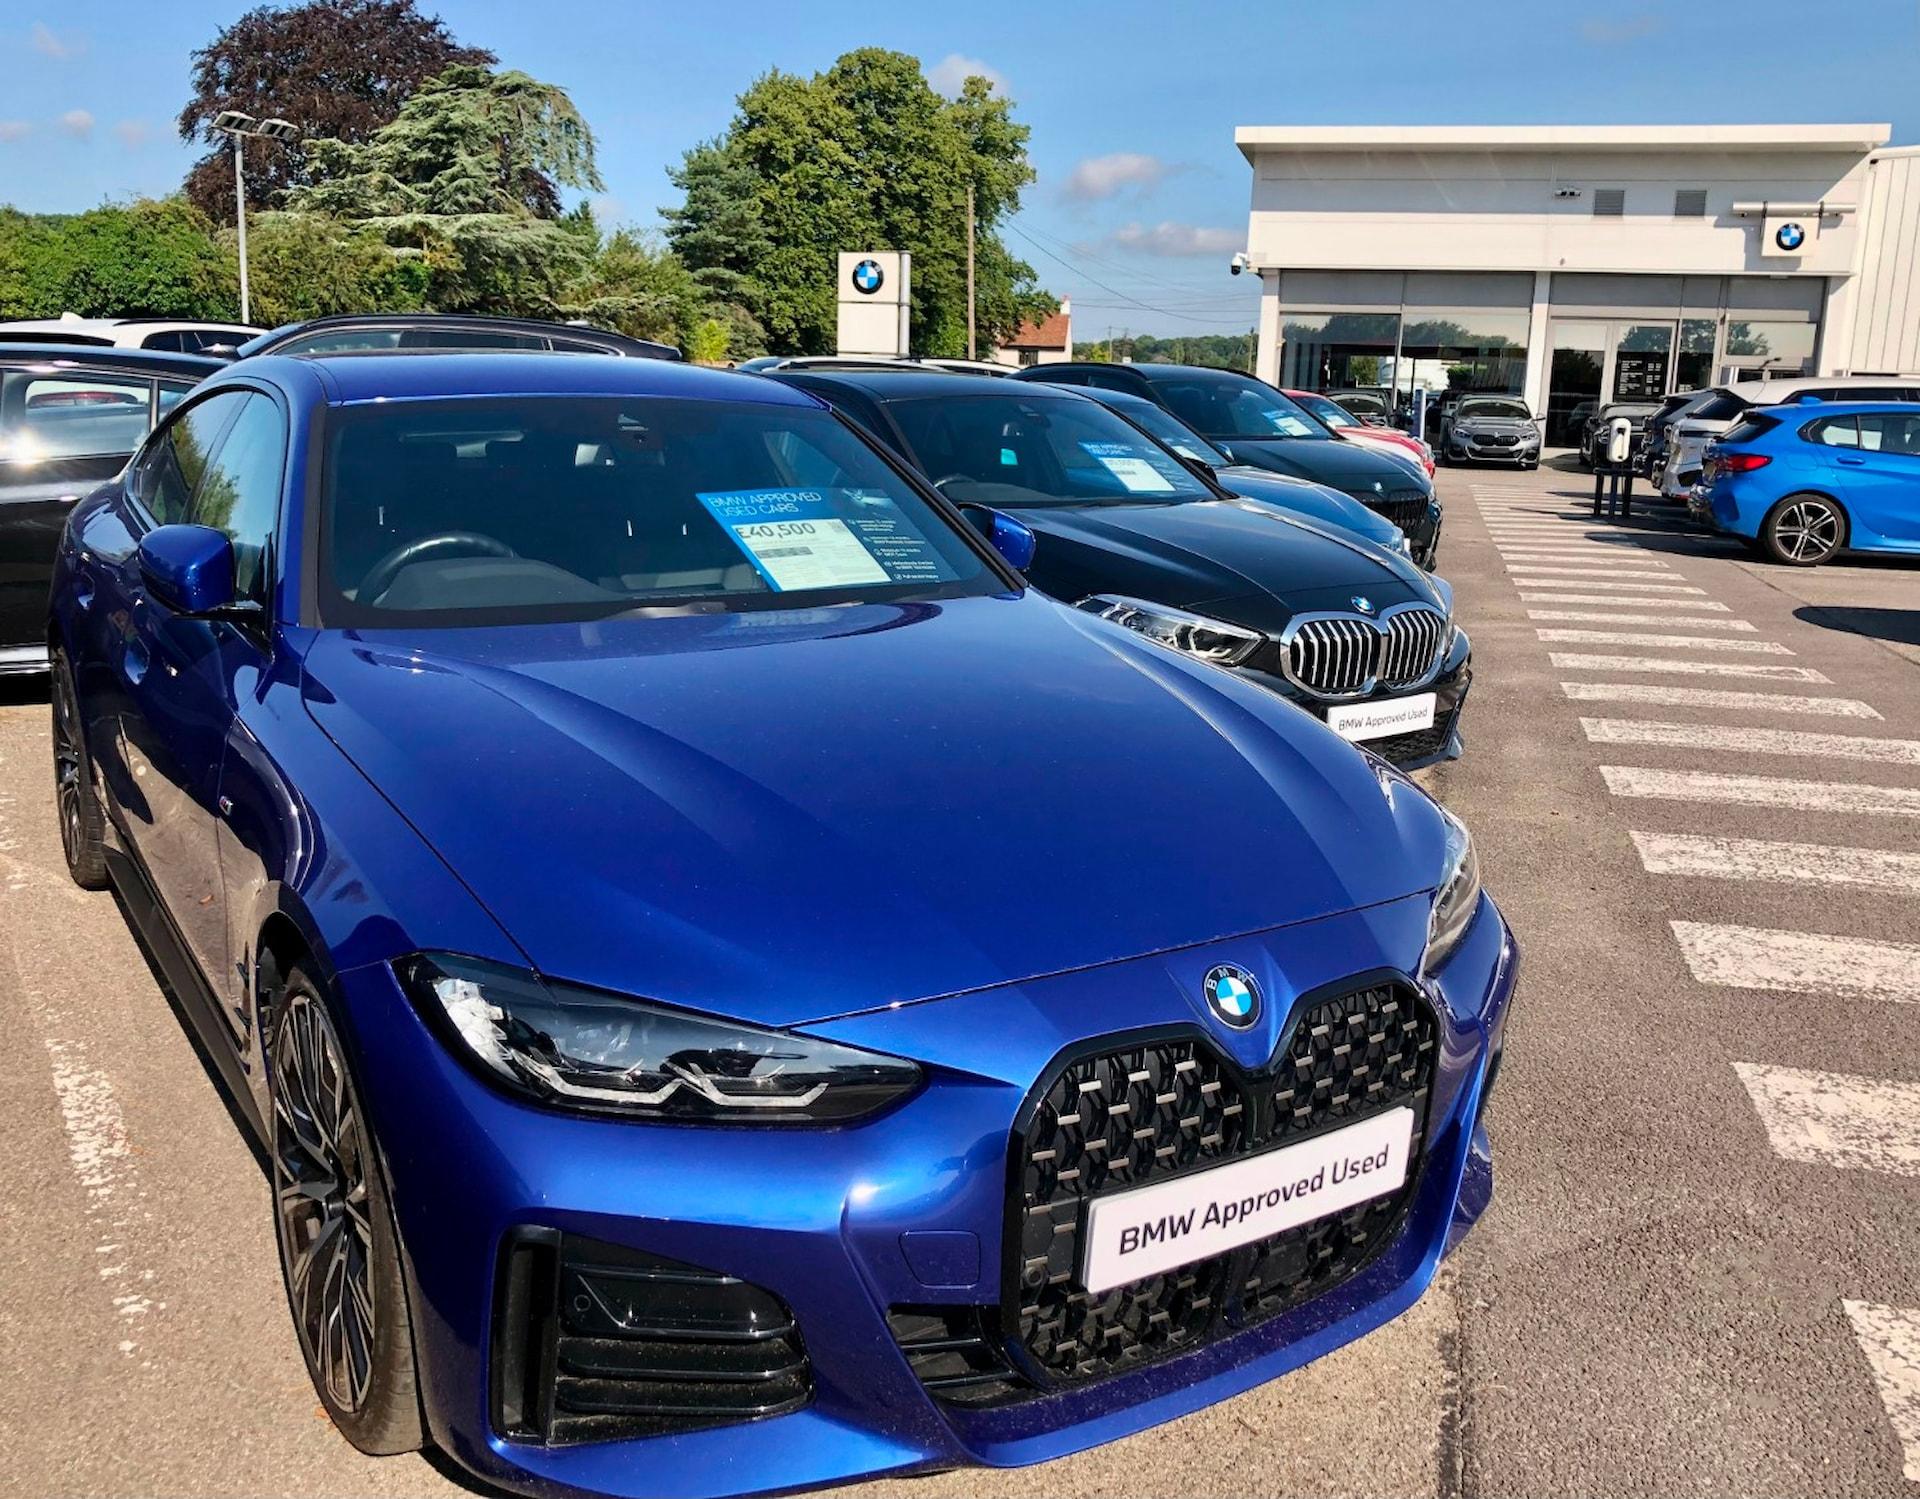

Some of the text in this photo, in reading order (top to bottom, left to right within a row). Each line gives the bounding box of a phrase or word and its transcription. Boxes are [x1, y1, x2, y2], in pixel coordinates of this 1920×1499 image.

[706, 491, 822, 508] BMW APPROVED
[716, 506, 758, 517] USED
[735, 522, 817, 540] £40,500
[1339, 706, 1427, 731] BMW Approved Used
[1118, 1143, 1390, 1256] BMW Approved Used
